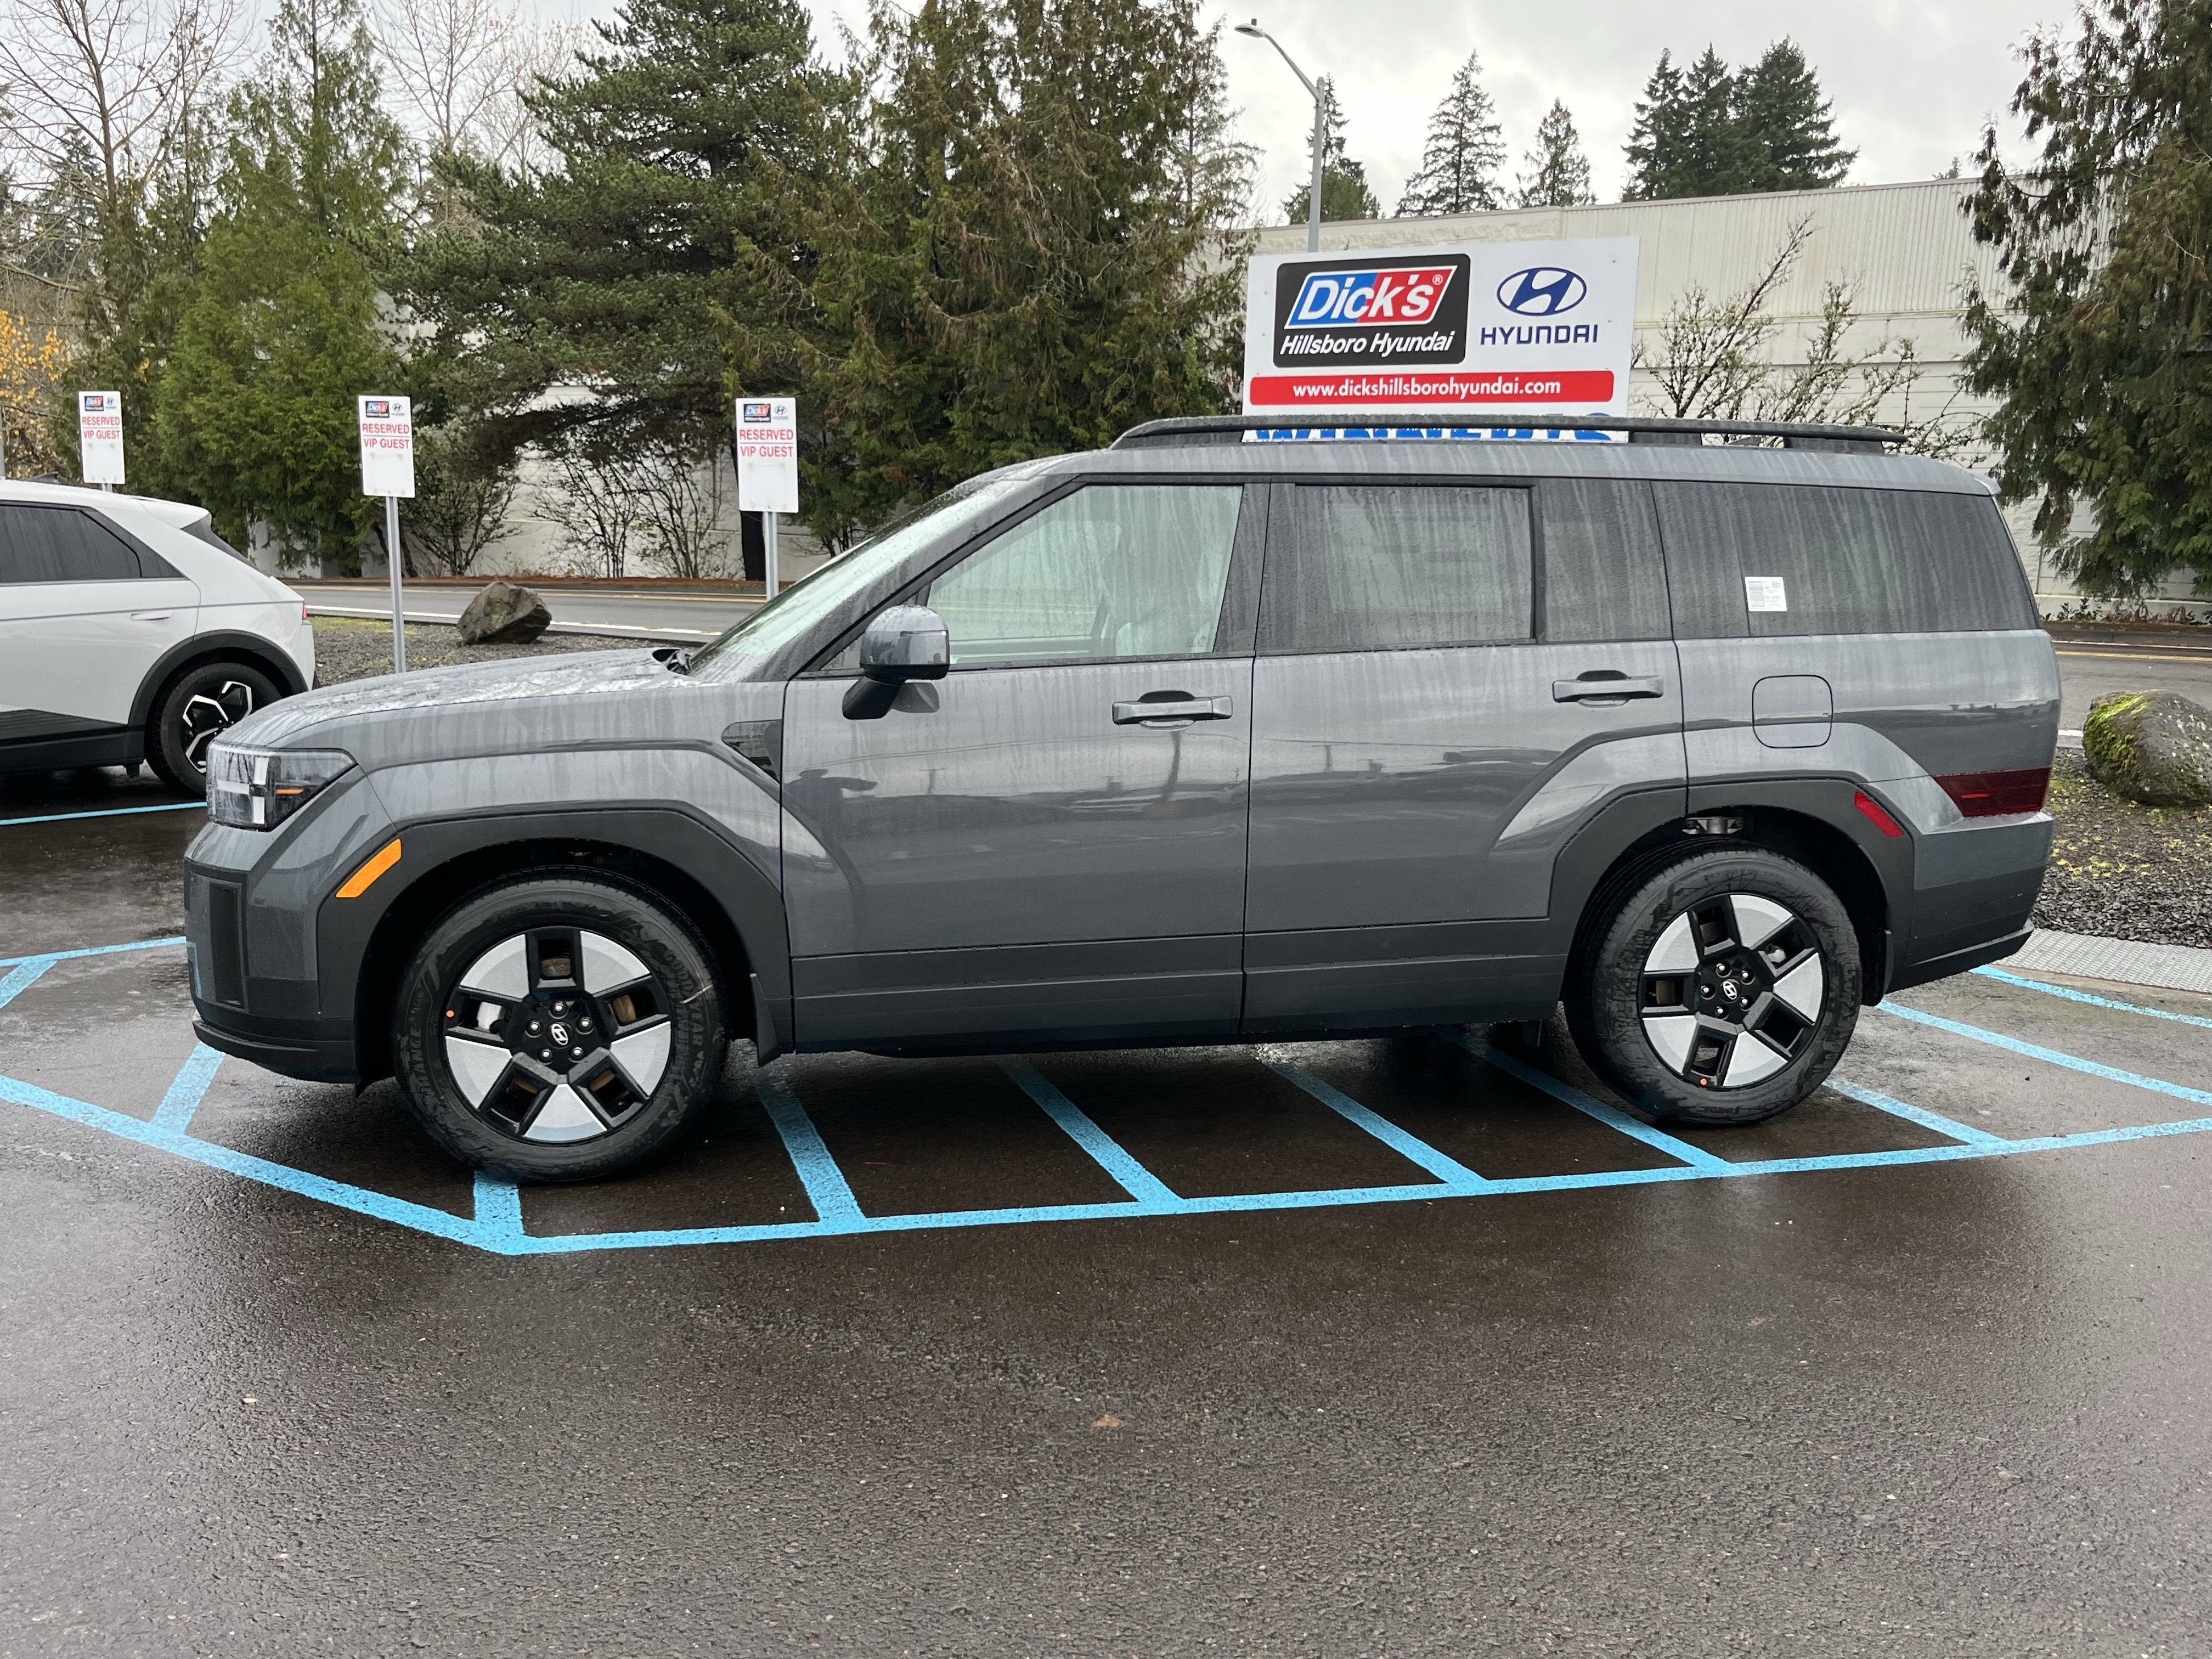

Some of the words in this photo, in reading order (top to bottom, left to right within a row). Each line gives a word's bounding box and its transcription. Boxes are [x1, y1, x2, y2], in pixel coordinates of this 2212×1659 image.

[1480, 324, 1599, 346] HYUNDAI
[1279, 334, 1367, 356] Hillsboro
[1369, 330, 1456, 358] Hyundai
[1293, 376, 1561, 400] www.dickshillsborohyundai.com
[82, 416, 120, 426] RESERVED
[83, 430, 95, 439] VIP
[96, 430, 121, 439] GUEST
[362, 423, 410, 435] RESERVED
[739, 429, 794, 441] RESERVED
[363, 438, 377, 448] VIP
[379, 438, 410, 449] GUEST
[740, 445, 757, 457] VIP
[759, 445, 794, 458] GUEST
